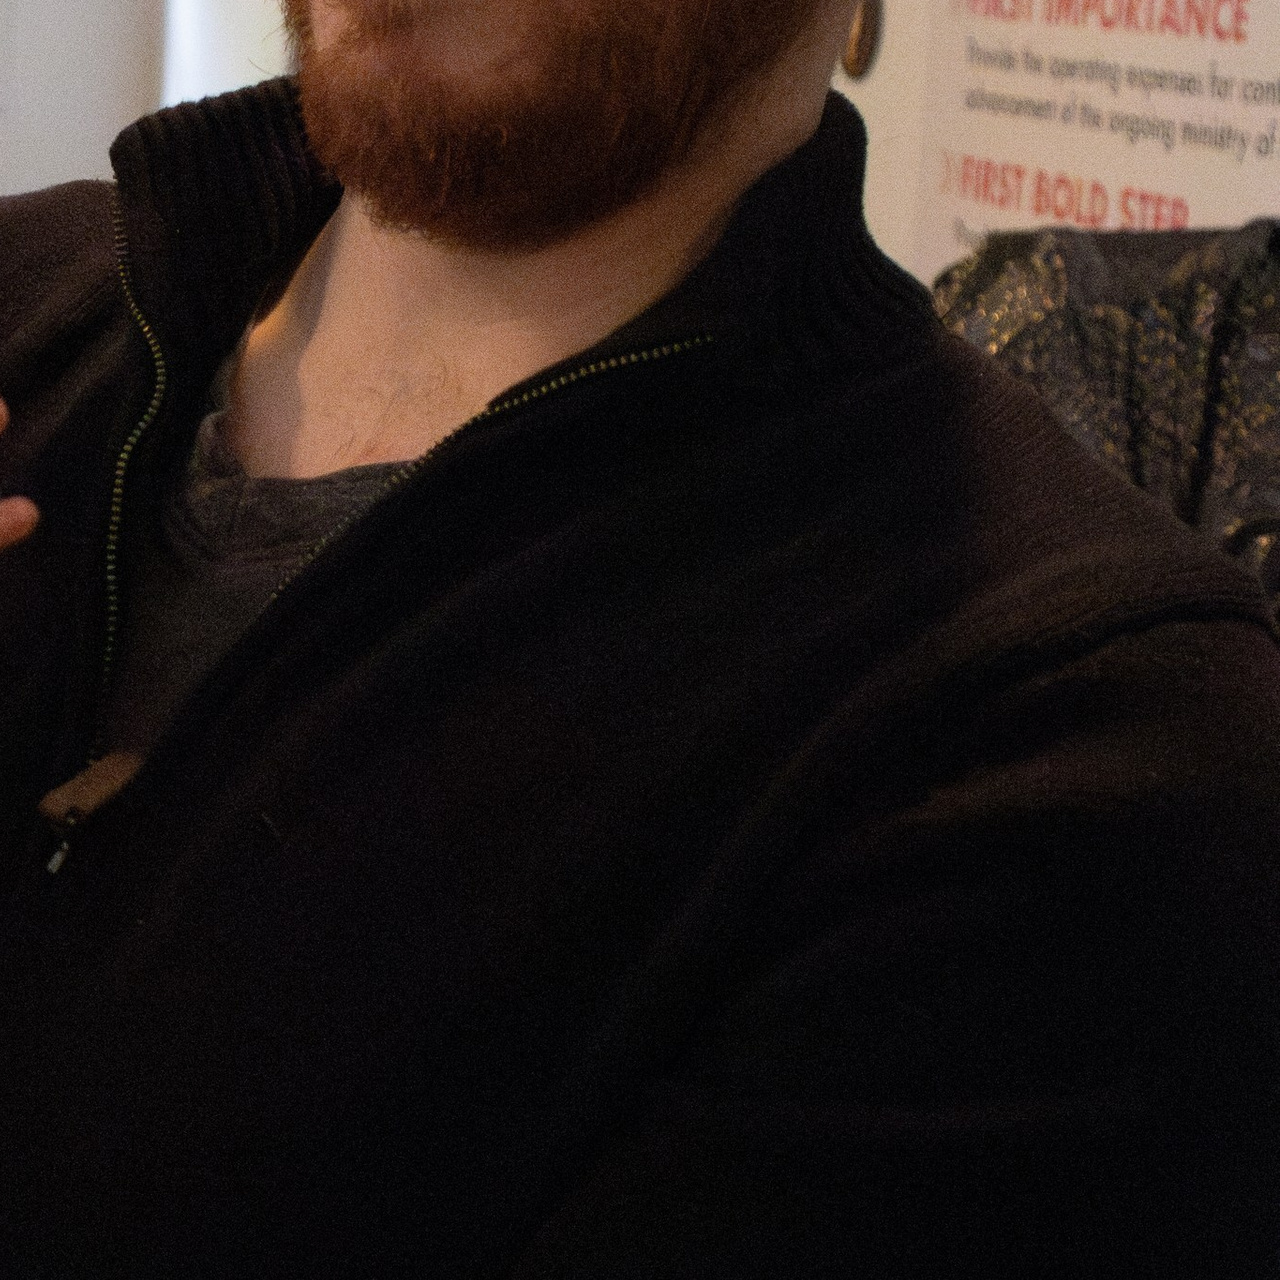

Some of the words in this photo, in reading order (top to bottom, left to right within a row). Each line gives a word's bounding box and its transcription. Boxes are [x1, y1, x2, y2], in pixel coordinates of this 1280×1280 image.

[1126, 64, 1203, 101] expenses
[1209, 60, 1235, 99] for
[1109, 110, 1176, 150] ongoing
[1182, 120, 1248, 163] ministry
[960, 154, 1026, 210] FIRST
[1031, 169, 1109, 227] BOLD
[1120, 186, 1190, 230] STEP
